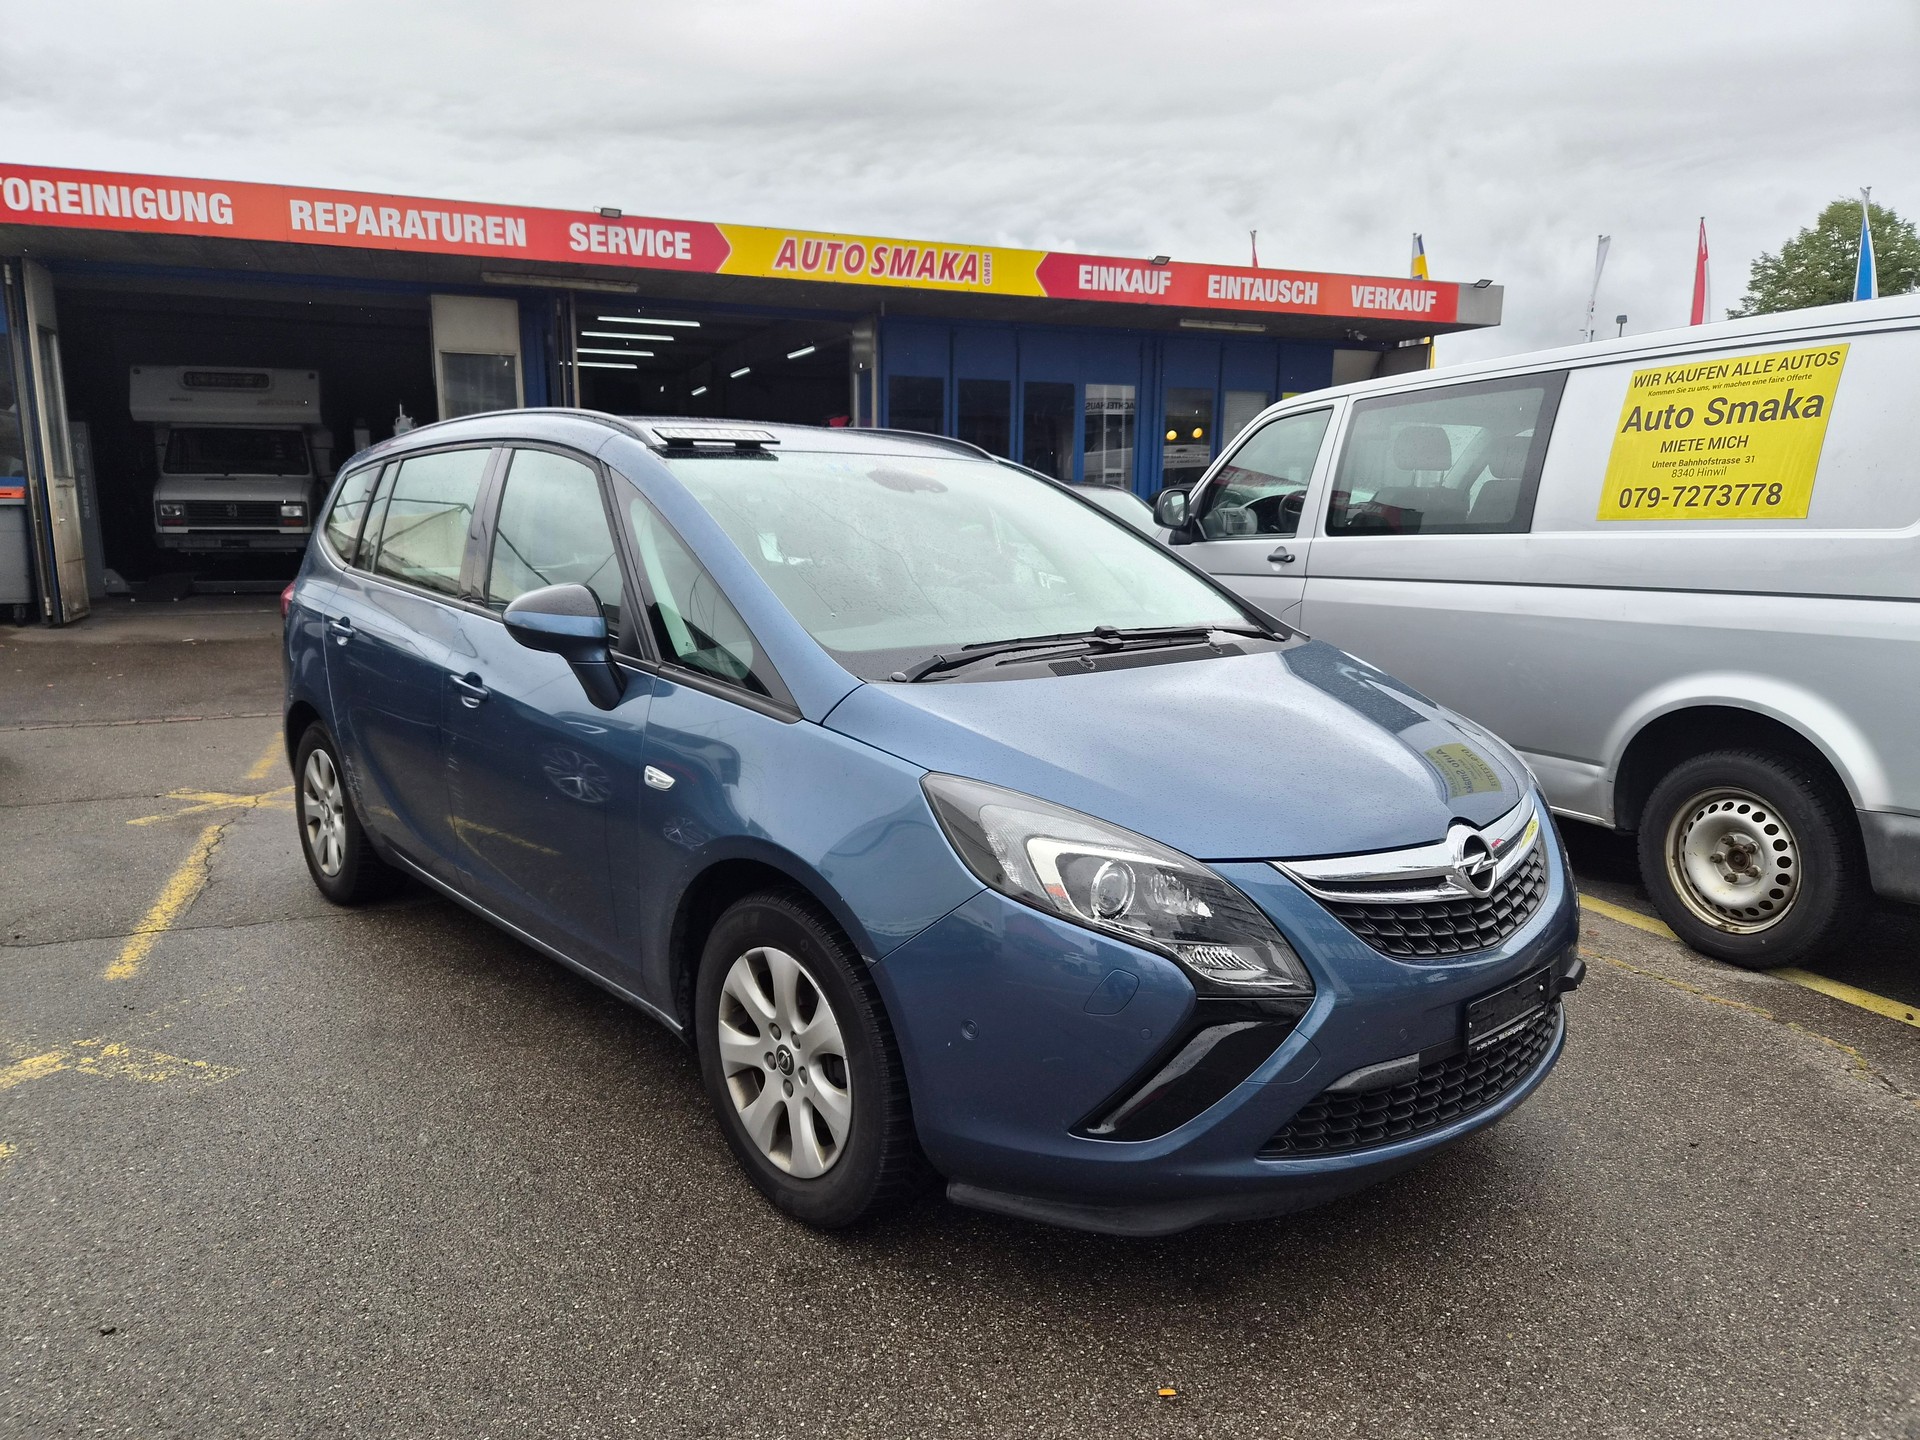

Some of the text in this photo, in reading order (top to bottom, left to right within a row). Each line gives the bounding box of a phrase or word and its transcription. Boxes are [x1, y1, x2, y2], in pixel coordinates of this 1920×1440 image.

[0, 177, 234, 225] OREINIGUNG
[289, 199, 527, 247] REPARATUREN
[569, 222, 692, 261] SERVICE
[774, 238, 978, 283] AUTO SMAKA
[983, 253, 992, 285] GMBH
[1078, 264, 1172, 296] EINKAUF
[1207, 274, 1319, 306] EINTAUSCH
[1351, 285, 1437, 313] VERKAUF
[1633, 350, 1840, 389] WIR KAUFEN ALLE AUTOS
[1647, 388, 1675, 397] Kommen
[1676, 386, 1687, 394] Sie
[1697, 384, 1711, 392] uns,
[1712, 382, 1722, 390] wir
[1723, 380, 1751, 389] machen
[1752, 378, 1767, 386] eine
[1768, 376, 1785, 384] faire
[1786, 373, 1813, 381] Offerte
[1621, 388, 1825, 434] Auto Smaka
[1660, 434, 1749, 454] MIETE MICH
[1651, 455, 1755, 469] Untere Bahnhofstrasse 31
[1671, 466, 1727, 478] 8340 Hinwil
[1618, 481, 1783, 509] 079-7273778
